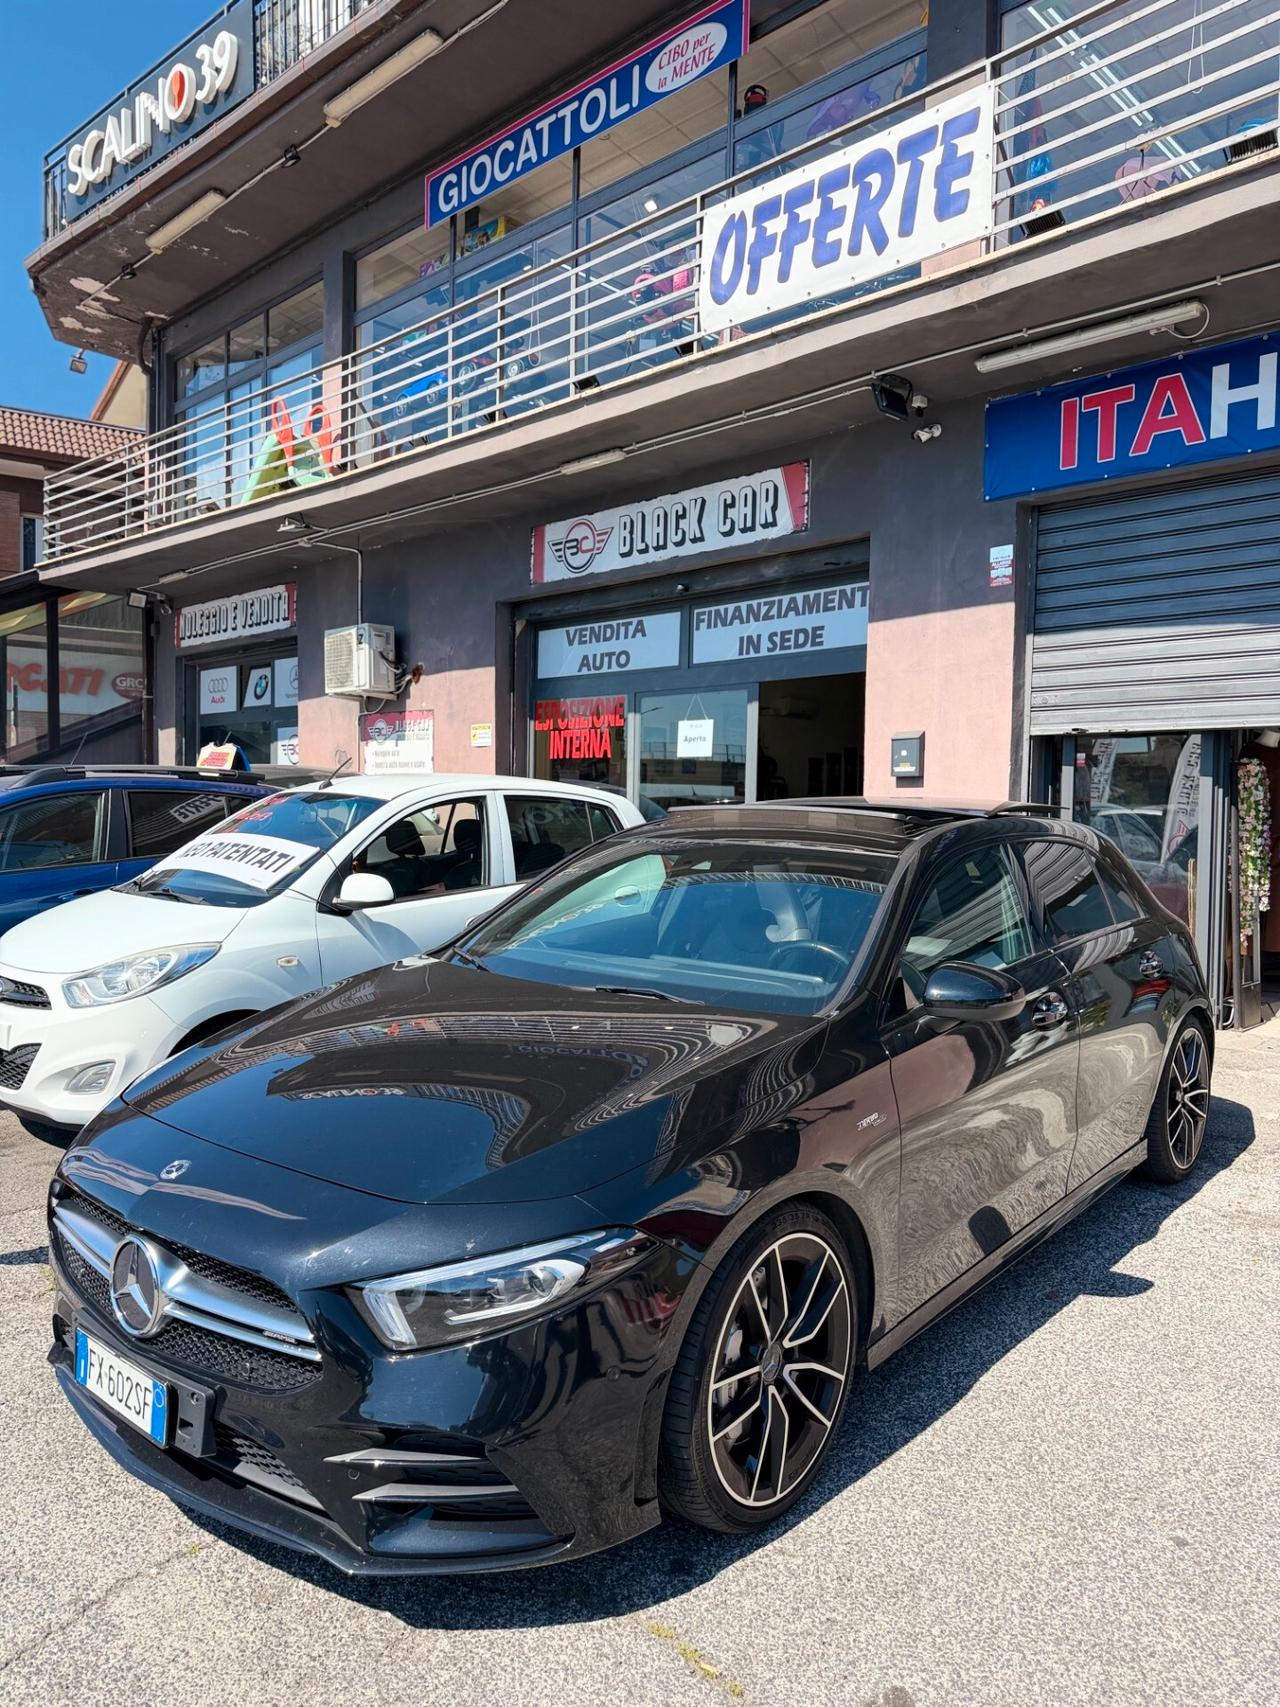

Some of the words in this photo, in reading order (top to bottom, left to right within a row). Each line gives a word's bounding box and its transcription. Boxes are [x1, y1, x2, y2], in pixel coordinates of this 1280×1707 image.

[657, 77, 668, 90] la
[671, 43, 716, 82] MENTE
[658, 39, 690, 70] CIBO
[692, 32, 711, 53] per
[67, 63, 197, 196] SCALINO
[195, 30, 238, 104] 39
[438, 64, 640, 213] GIOCATTOLI
[709, 106, 981, 306] OFFERTE
[618, 496, 706, 558] BLACK
[718, 480, 779, 537] CAR
[179, 604, 229, 640] NOLEGGIO
[231, 601, 238, 631] E
[240, 591, 290, 629] VENDITA
[565, 619, 647, 647] VENDITA
[737, 633, 762, 656] IN
[766, 625, 825, 653] SEDE
[577, 650, 631, 673] AUTO
[210, 695, 225, 704] Audi
[534, 695, 625, 731] ESPOSIZIONE
[549, 728, 612, 760] INTERNA
[683, 735, 707, 743] Aperto
[206, 841, 296, 873] PATENTATI
